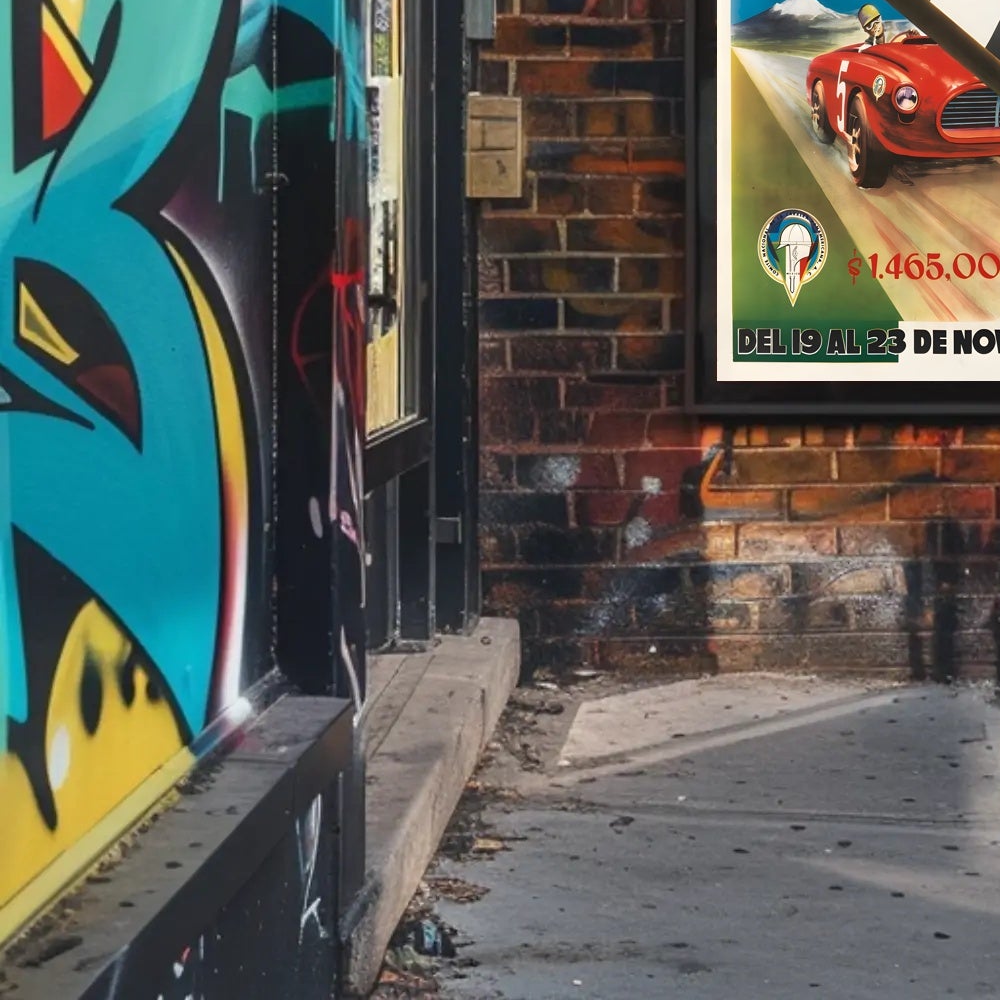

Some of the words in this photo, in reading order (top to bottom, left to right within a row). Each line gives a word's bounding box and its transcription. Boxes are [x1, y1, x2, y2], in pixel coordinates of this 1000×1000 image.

[836, 60, 850, 132] 5
[737, 328, 787, 355] DEL
[792, 328, 823, 355] 19
[826, 329, 862, 355] AL
[867, 328, 906, 355] 23
[913, 329, 948, 355] DE
